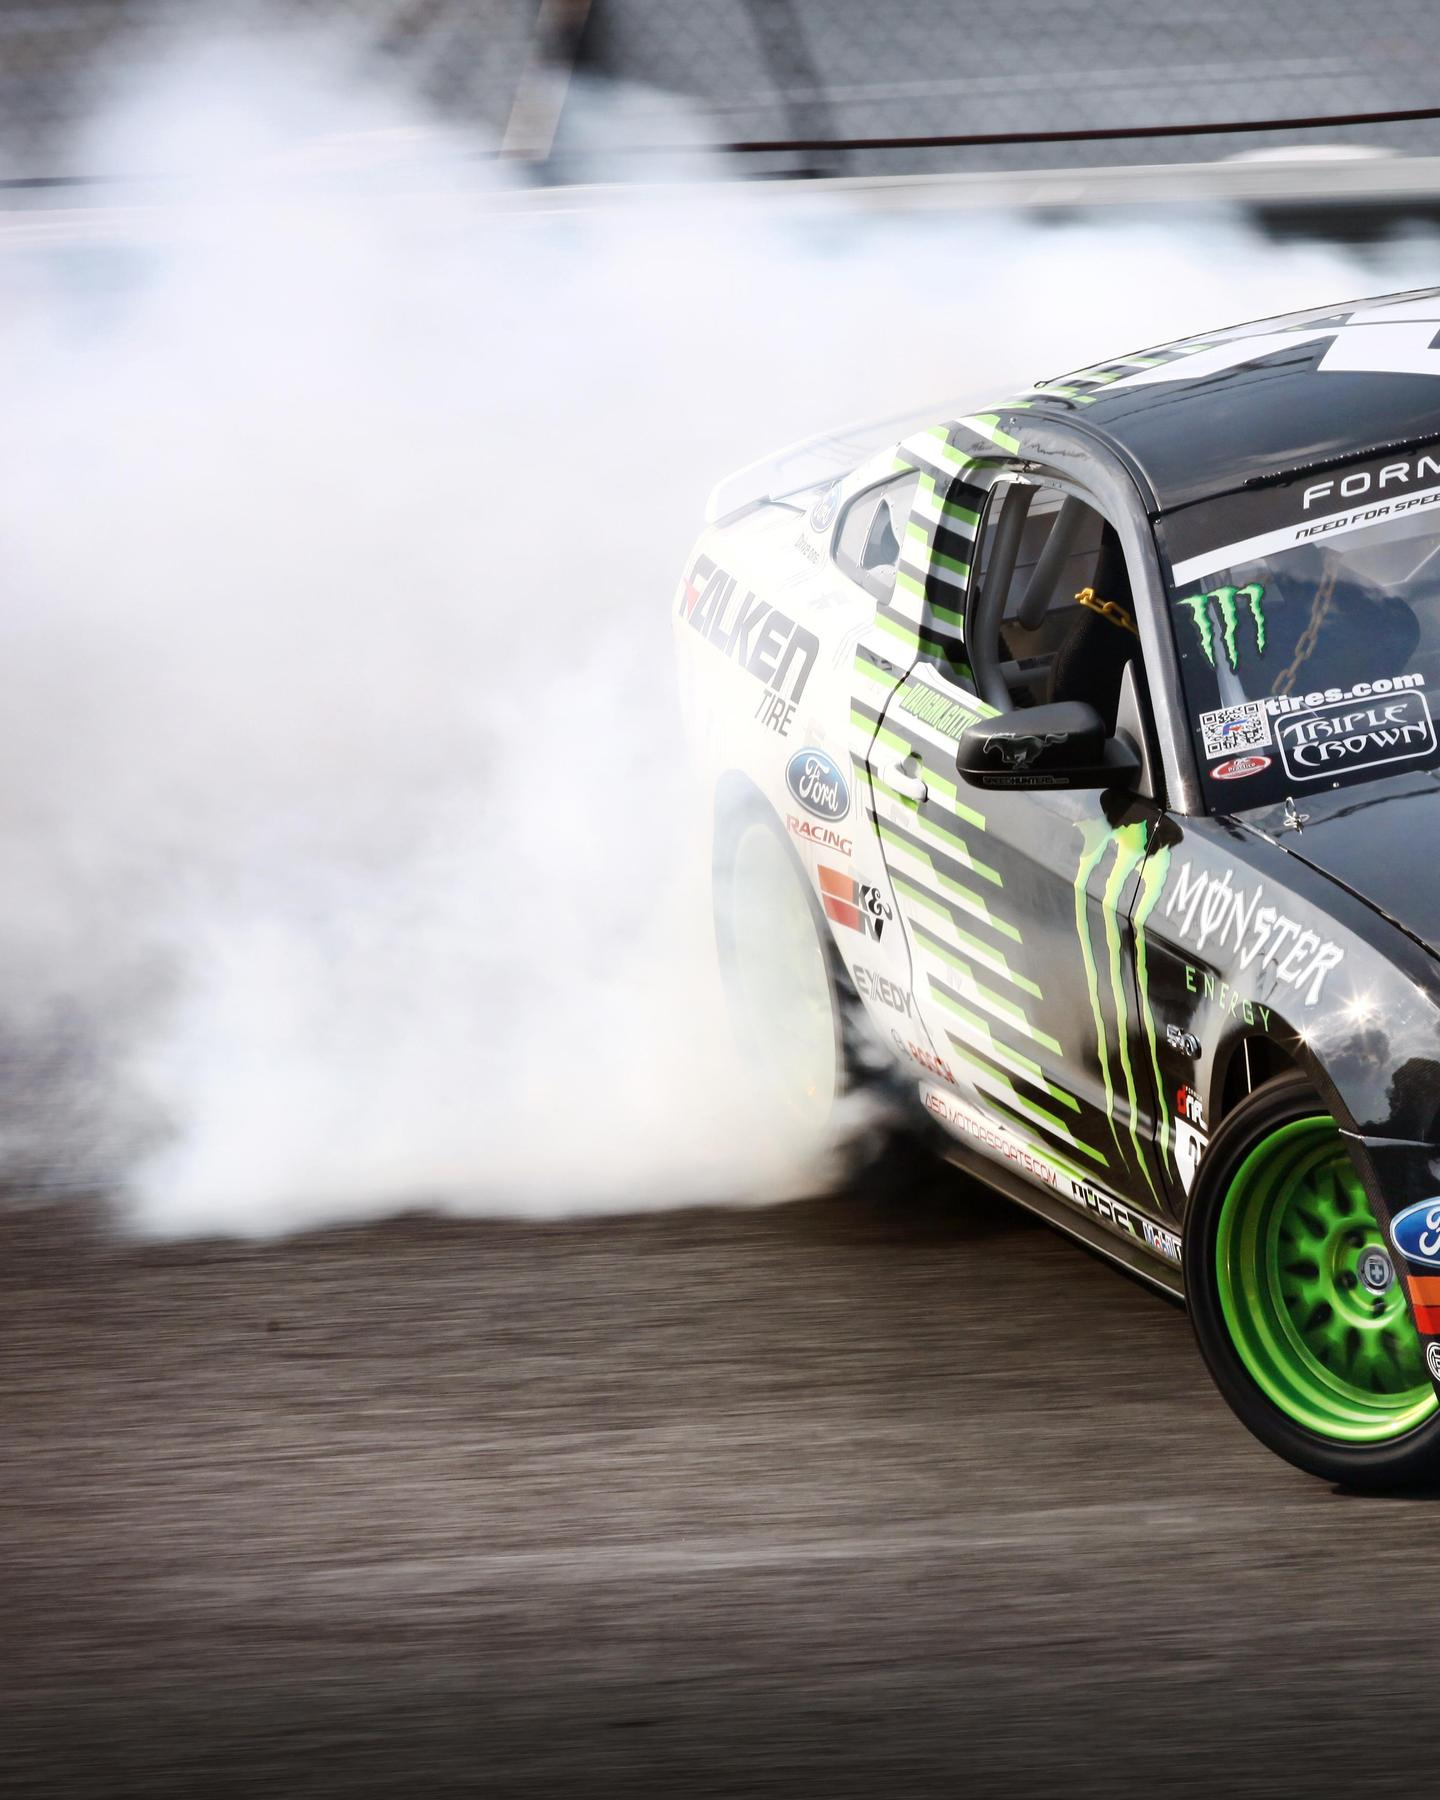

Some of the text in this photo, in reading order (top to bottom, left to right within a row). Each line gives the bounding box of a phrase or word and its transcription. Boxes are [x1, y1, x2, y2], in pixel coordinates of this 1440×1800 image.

[1295, 517, 1348, 540] NEED
[1351, 506, 1391, 525] FOR
[679, 553, 819, 704] FALKEN
[755, 690, 797, 737] TIRE
[1265, 672, 1425, 715] tires.com
[1283, 703, 1408, 745] TRIPLE
[1292, 720, 1428, 767] CROWN
[799, 756, 839, 812] Ford
[786, 815, 853, 856] RACING
[852, 963, 912, 1018] EXEDY
[1185, 965, 1271, 1033] ENERGY
